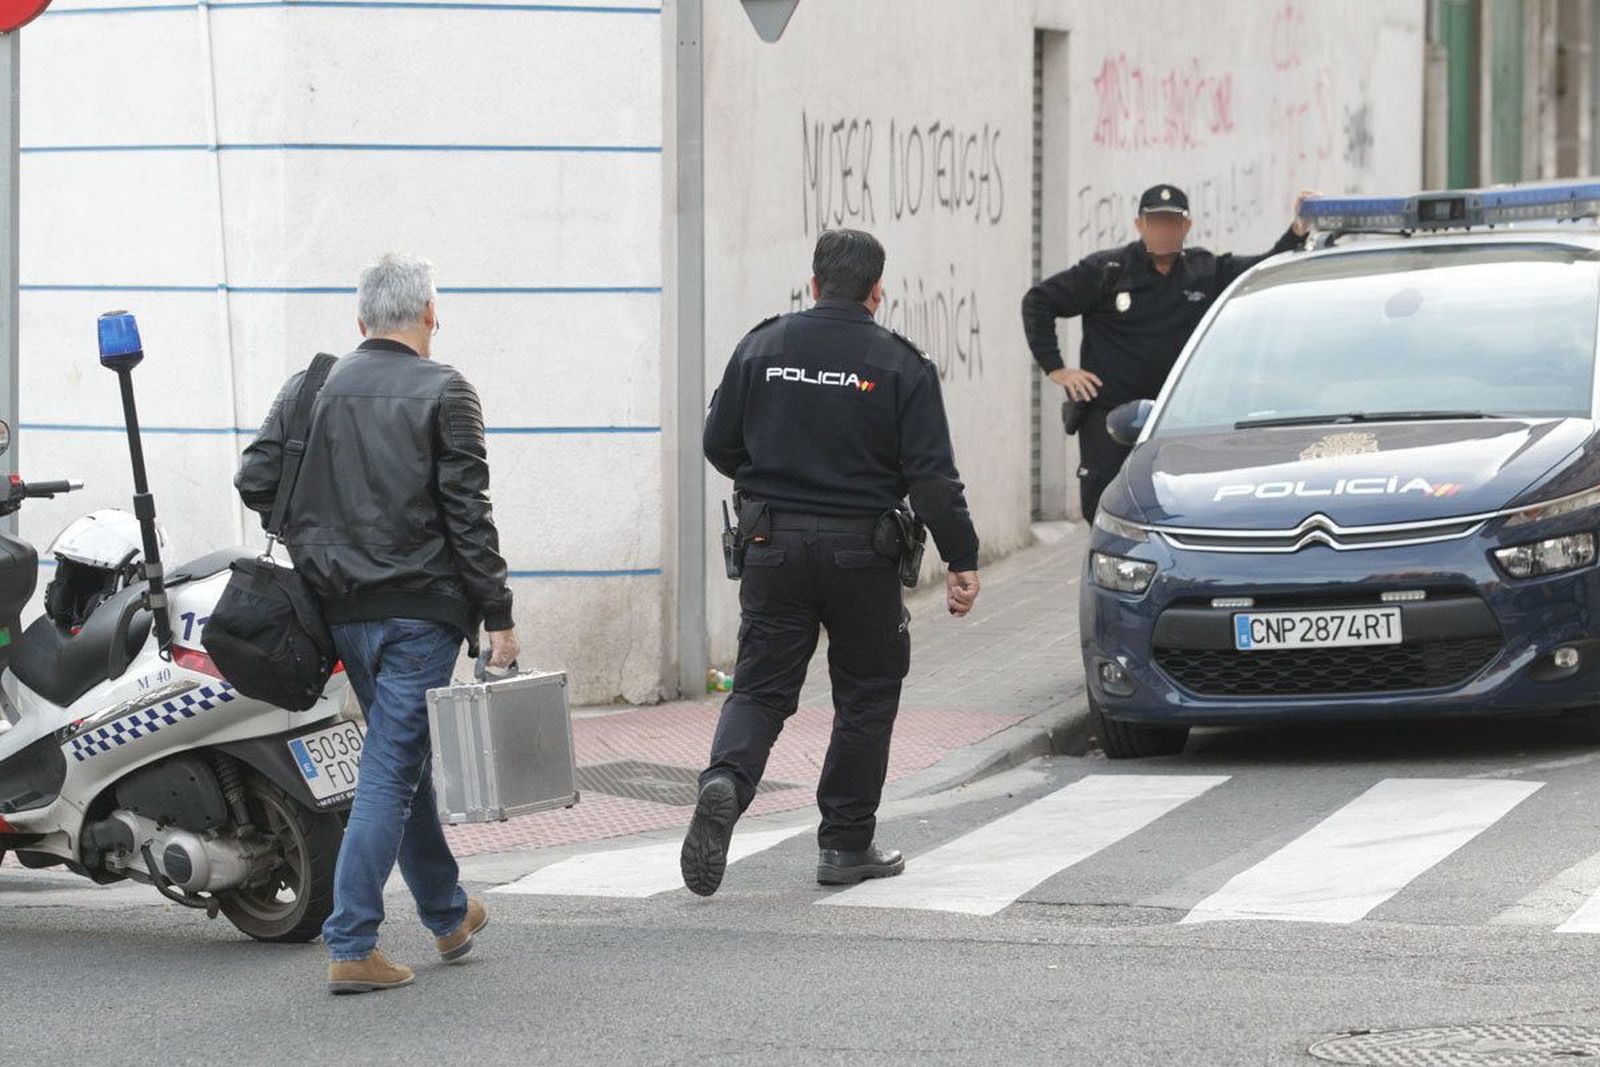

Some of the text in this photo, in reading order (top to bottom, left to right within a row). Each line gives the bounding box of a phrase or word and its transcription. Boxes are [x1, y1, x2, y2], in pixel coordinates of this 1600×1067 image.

[802, 110, 875, 237] MUJER
[766, 367, 861, 387] POLICIA
[306, 728, 362, 763] 5036
